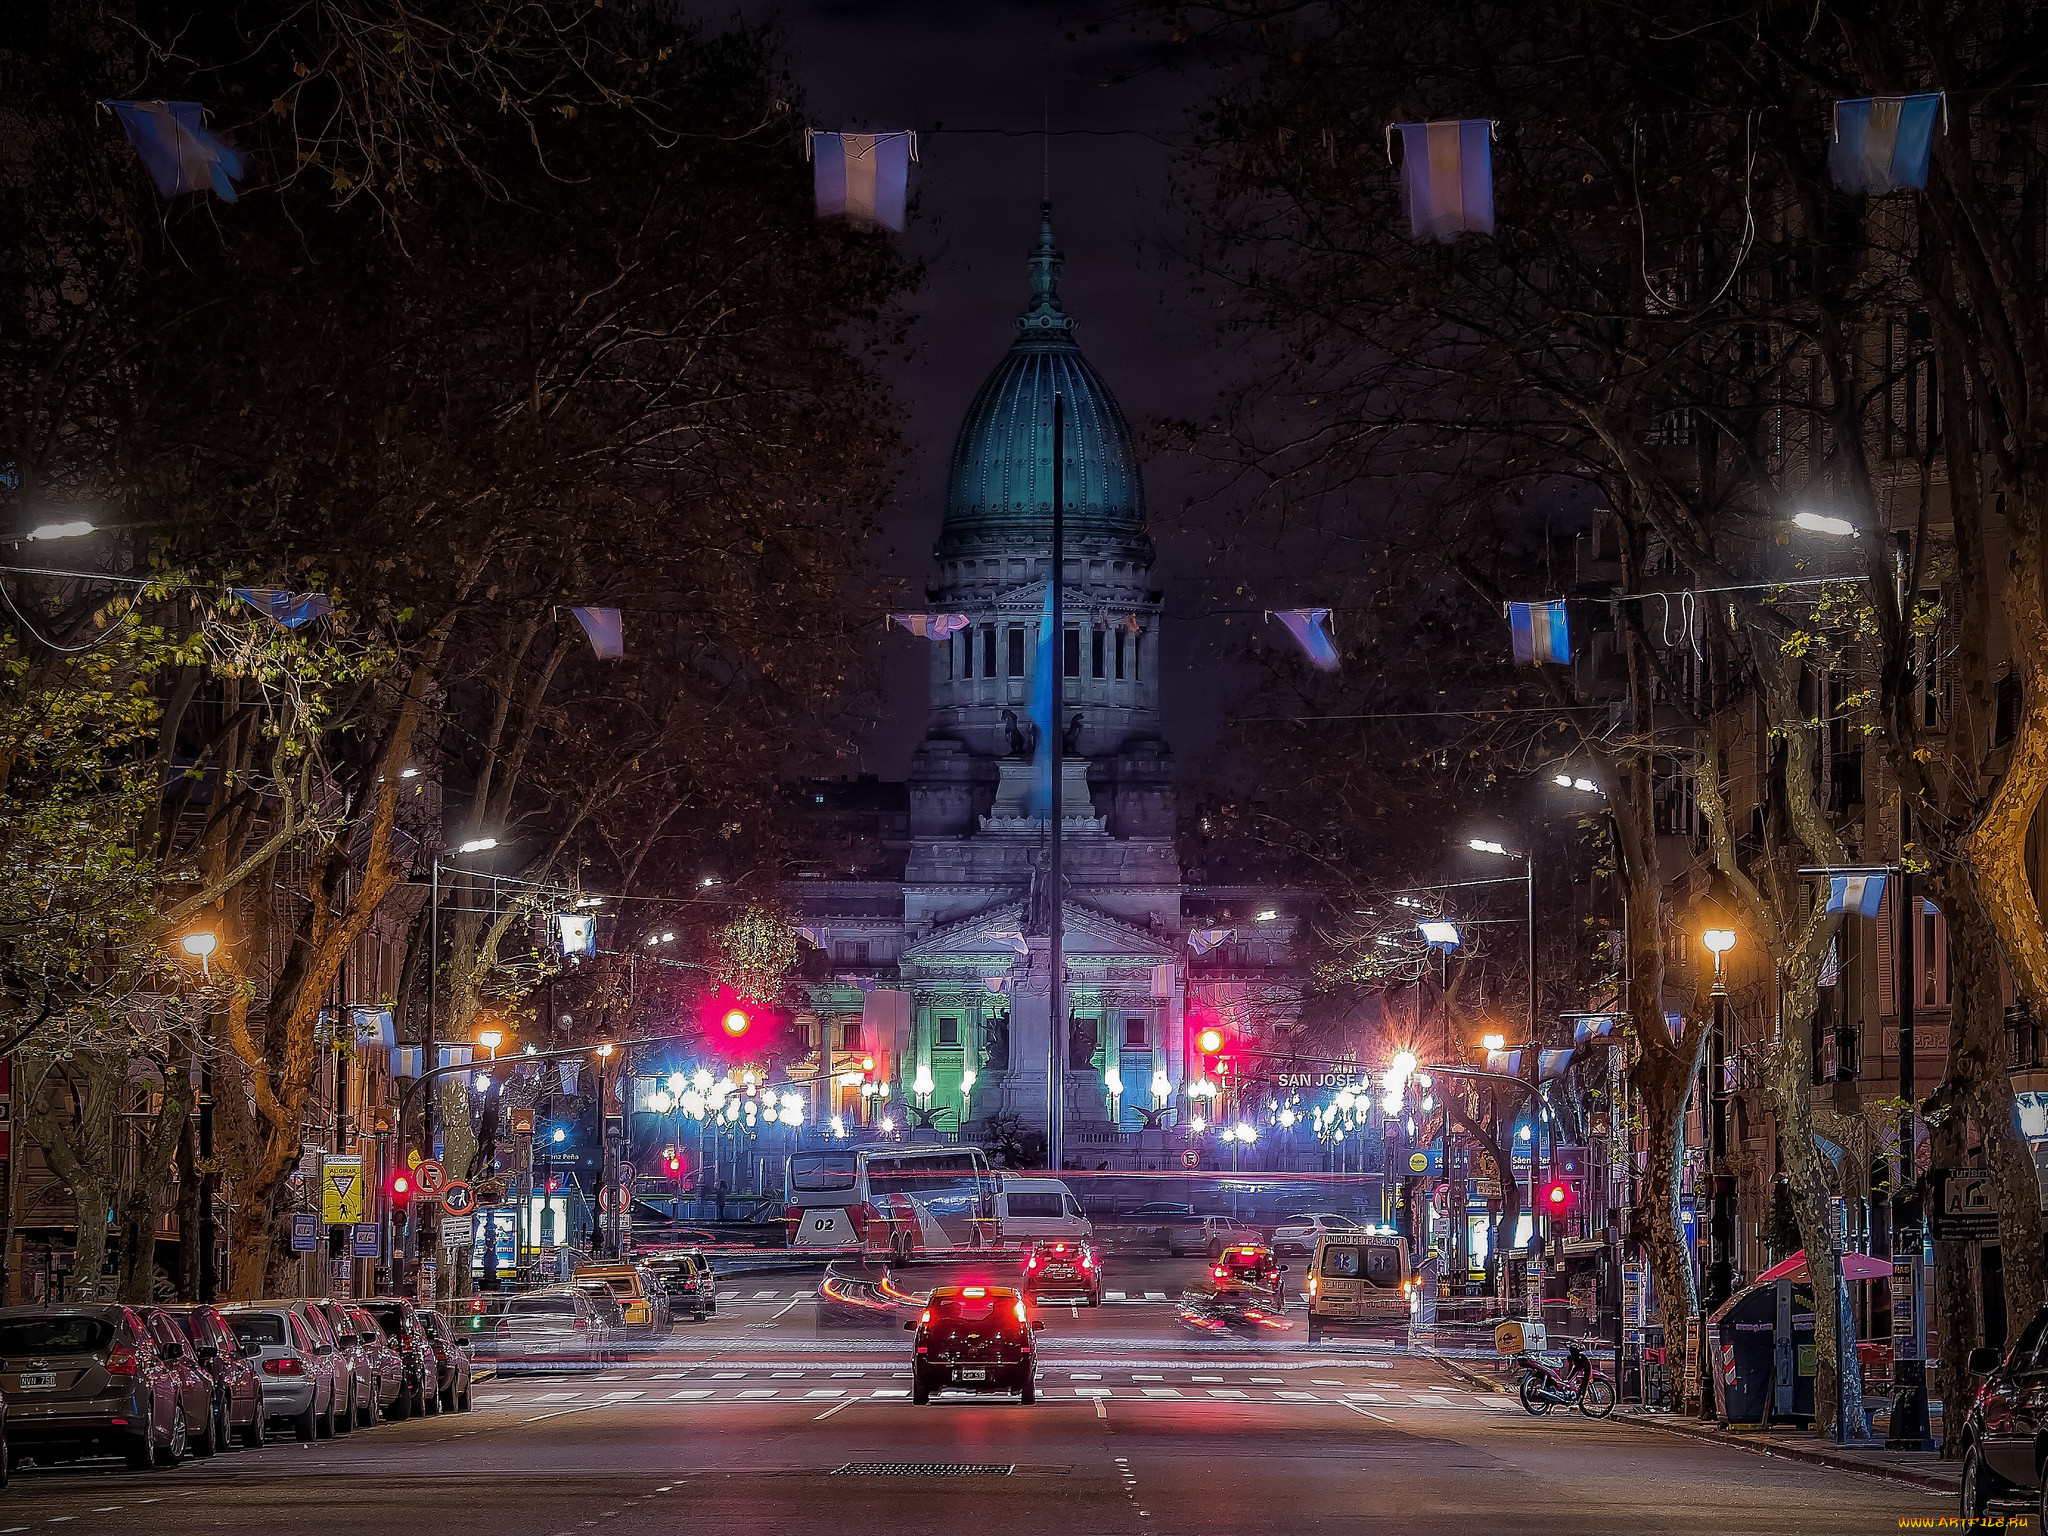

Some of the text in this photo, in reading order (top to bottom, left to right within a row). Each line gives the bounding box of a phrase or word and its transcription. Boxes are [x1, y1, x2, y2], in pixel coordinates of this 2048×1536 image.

[1278, 1074, 1311, 1087] SAN
[1949, 1167, 1989, 1178] Turism
[814, 1218, 835, 1232] 02
[1324, 1235, 1351, 1244] UNIDAD
